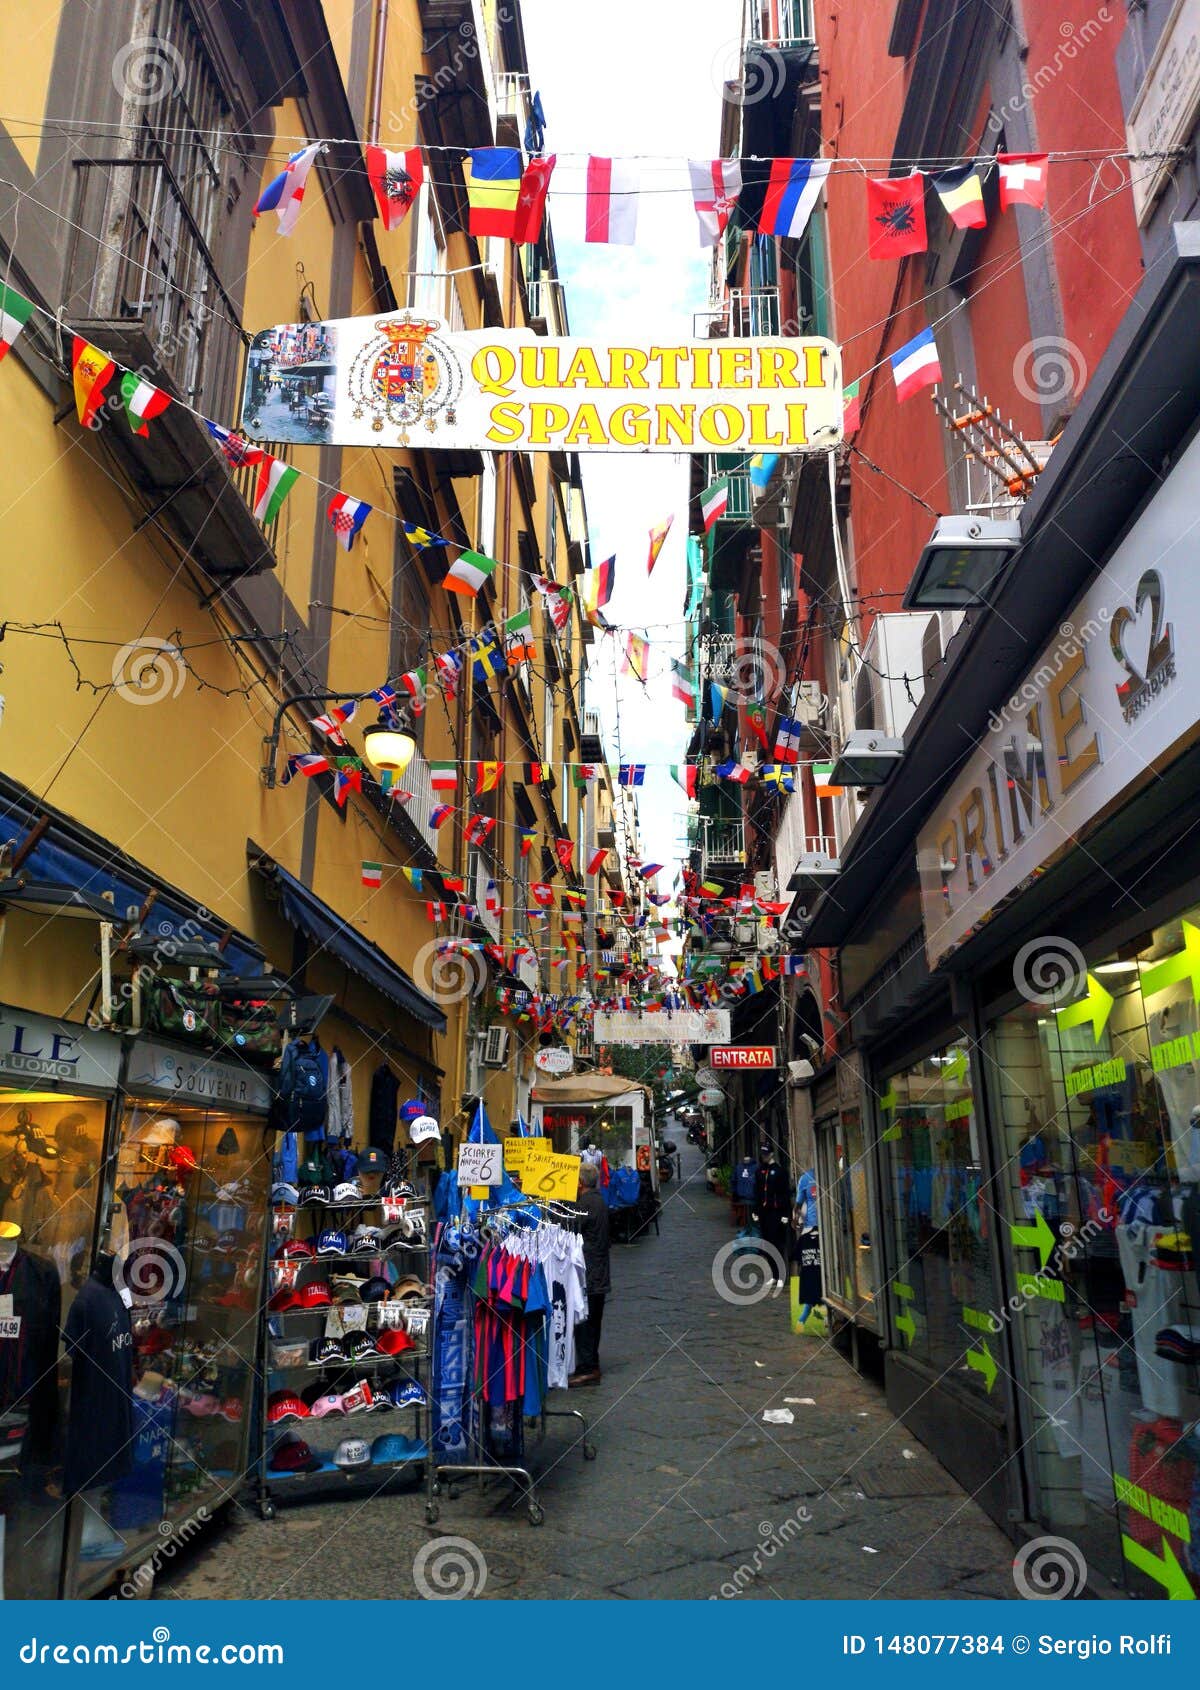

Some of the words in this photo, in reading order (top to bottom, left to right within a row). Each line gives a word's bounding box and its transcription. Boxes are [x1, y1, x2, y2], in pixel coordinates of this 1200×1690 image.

[471, 345, 826, 397] QUARTIERI
[486, 402, 809, 446] SPAGNOLI
[937, 645, 1103, 918] PRIME
[0, 1022, 81, 1064] LE
[714, 1051, 772, 1065] ENTRATA
[11, 1056, 71, 1076] UOMO
[174, 1066, 248, 1100] SOUVENIR
[461, 1147, 497, 1158] SCIARPE
